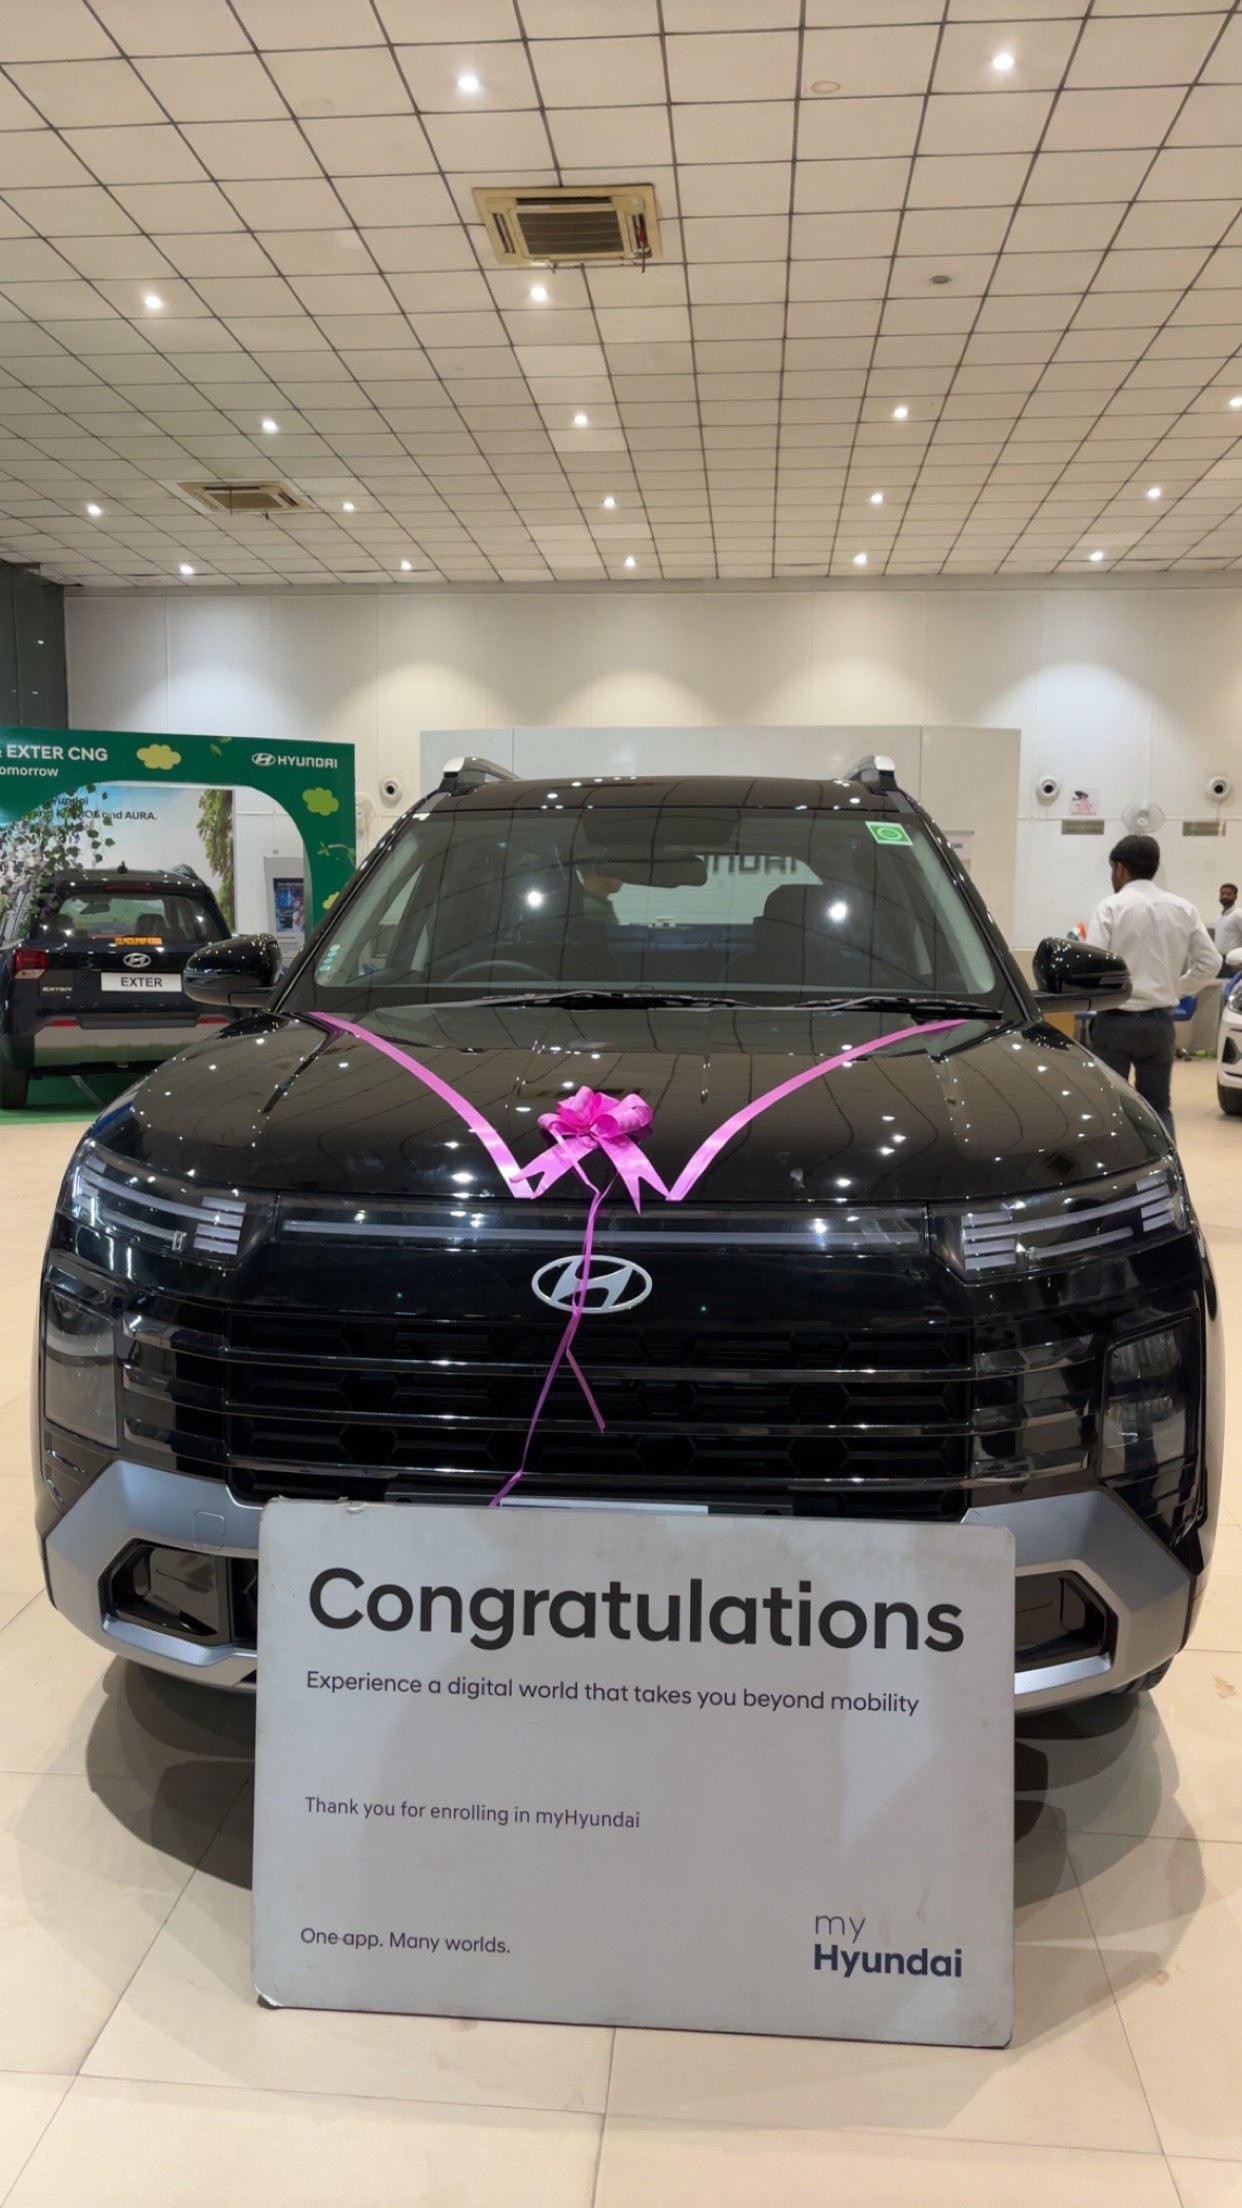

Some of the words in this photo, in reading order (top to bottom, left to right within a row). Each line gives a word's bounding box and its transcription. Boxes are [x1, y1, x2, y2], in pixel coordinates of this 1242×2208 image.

[6, 744, 64, 760] EXTER
[67, 746, 108, 761] CNG
[277, 755, 338, 769] HYUNDAI
[0, 766, 59, 777] omorrow
[124, 811, 158, 820] AURA.
[120, 976, 163, 988] EXTER
[308, 1567, 965, 1653] Congratulations
[306, 1671, 423, 1695] Experience
[428, 1679, 442, 1694] a
[447, 1675, 513, 1700] digital
[518, 1680, 579, 1699] world
[583, 1682, 629, 1703] that
[633, 1684, 692, 1705] takes
[697, 1691, 737, 1710] you
[743, 1688, 825, 1712] beyond
[830, 1692, 920, 1718] mobility
[304, 1797, 359, 1816] Thank
[363, 1804, 395, 1820] you
[400, 1801, 427, 1818] for
[430, 1804, 509, 1828] enrolling
[514, 1806, 530, 1823] in
[535, 1809, 640, 1830] myHyundai
[301, 1928, 339, 1944] One
[342, 1932, 384, 1951] app.
[389, 1932, 440, 1953] Many
[444, 1935, 511, 1954] worlds.
[815, 1915, 866, 1943] my
[814, 1944, 963, 1979] Hyundai
